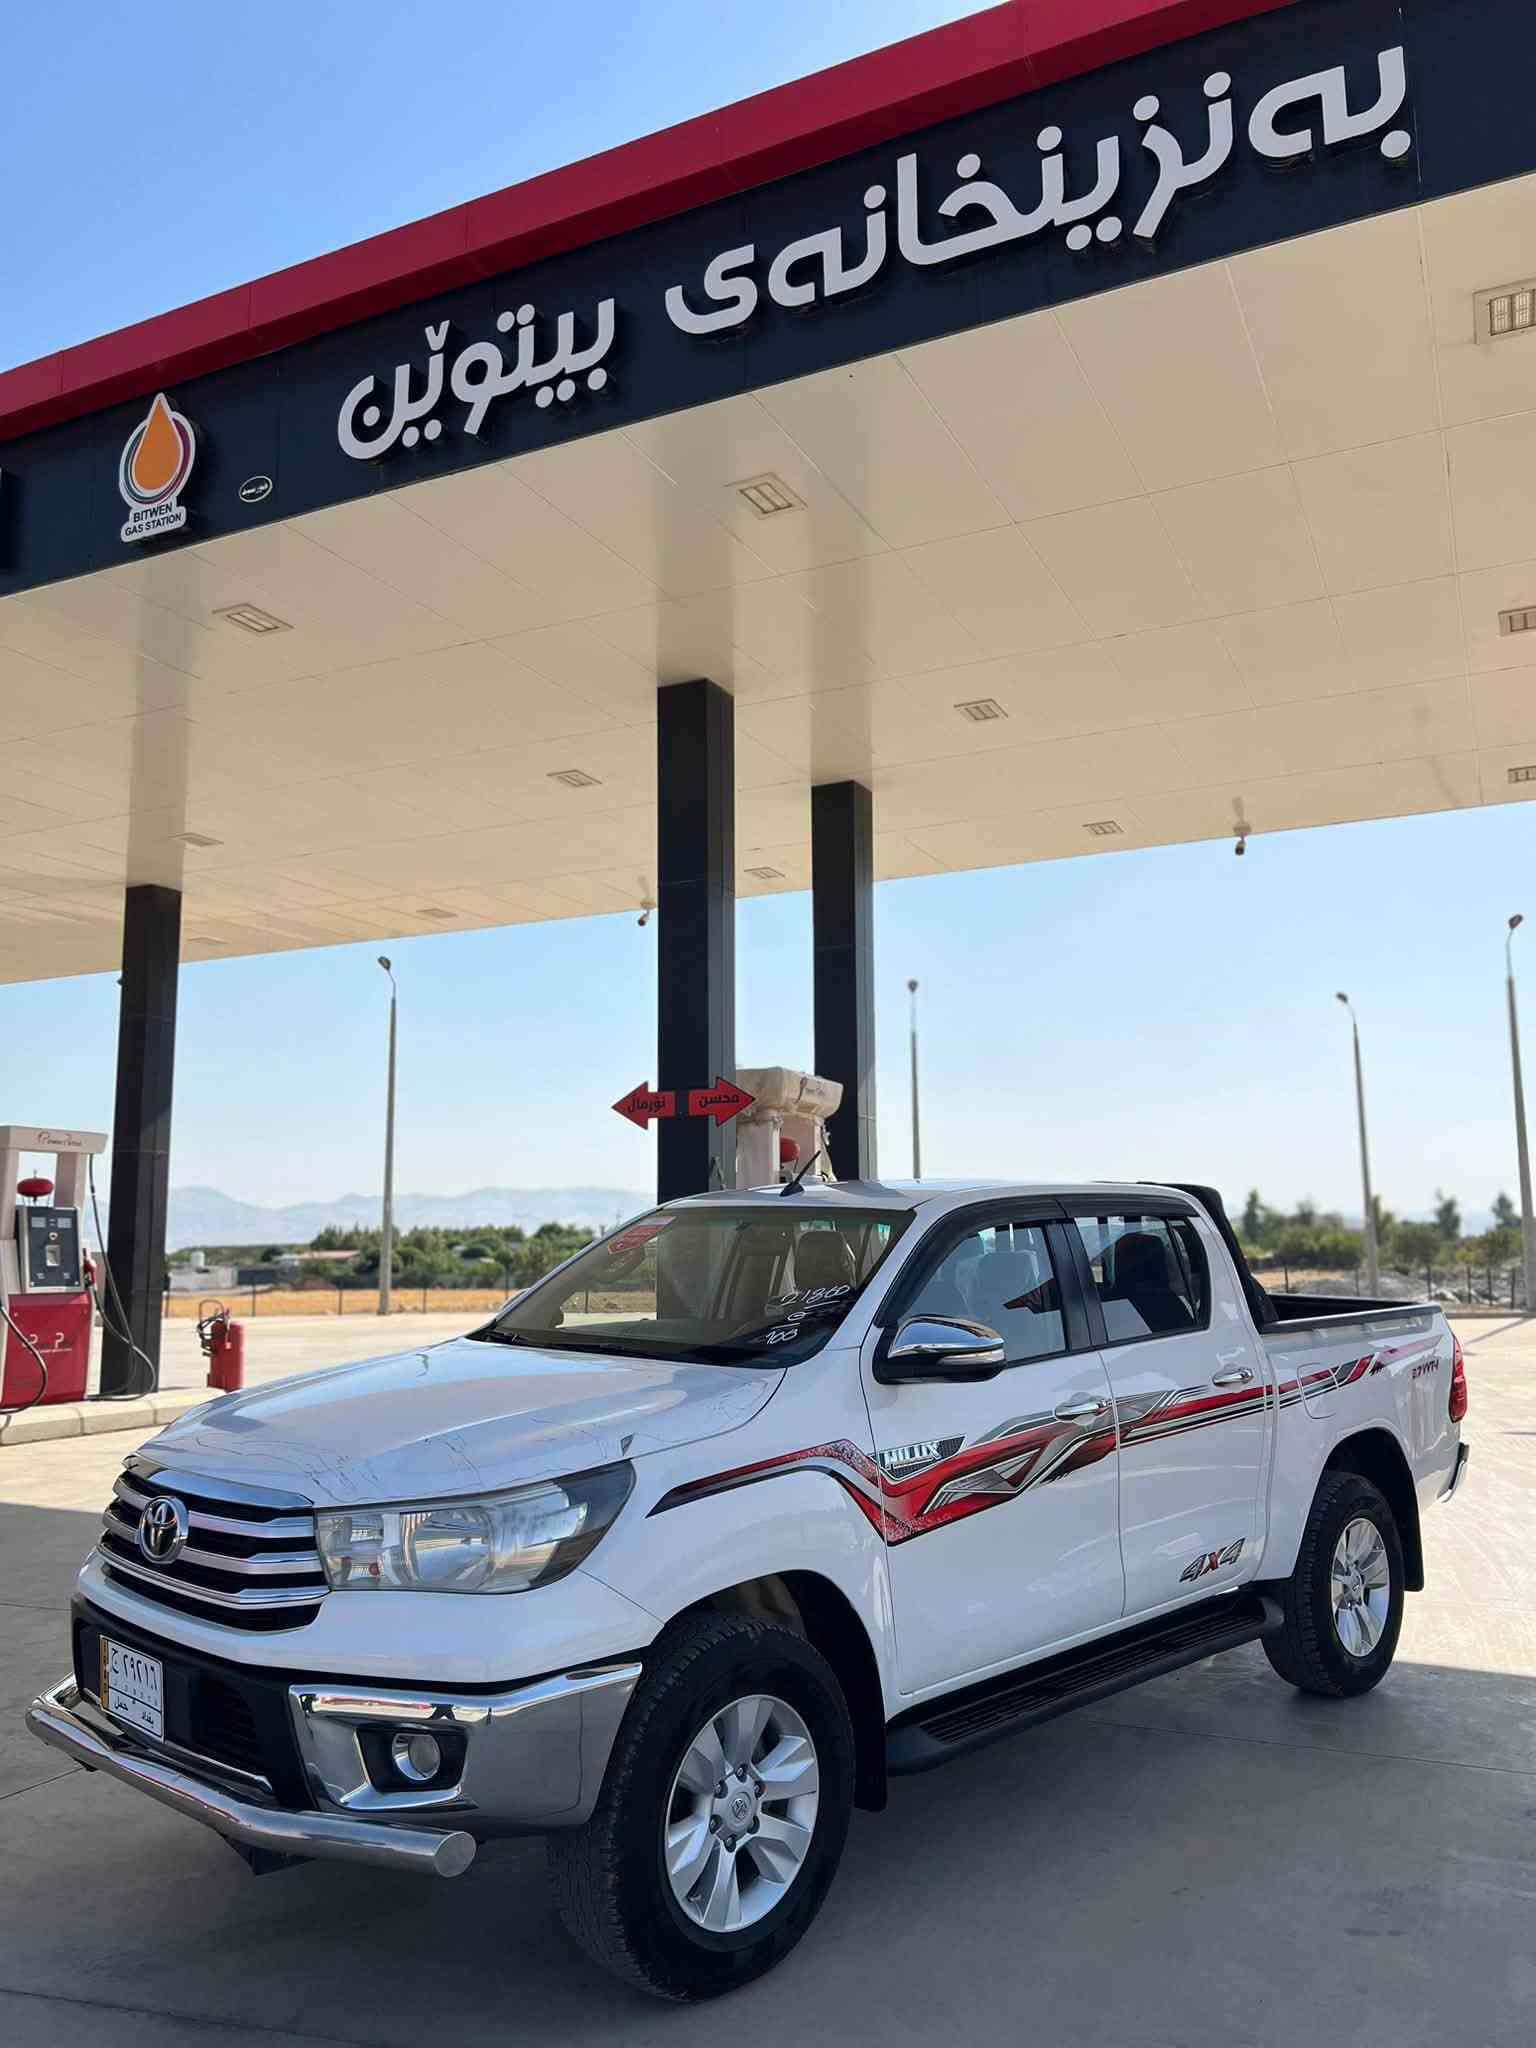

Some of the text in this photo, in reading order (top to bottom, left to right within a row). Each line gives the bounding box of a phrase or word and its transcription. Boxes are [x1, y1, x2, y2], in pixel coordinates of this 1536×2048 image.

[133, 502, 173, 523] BITWEN
[125, 512, 182, 537] GAS STATION
[699, 1093, 740, 1108] محسن
[882, 1441, 942, 1471] HILUX
